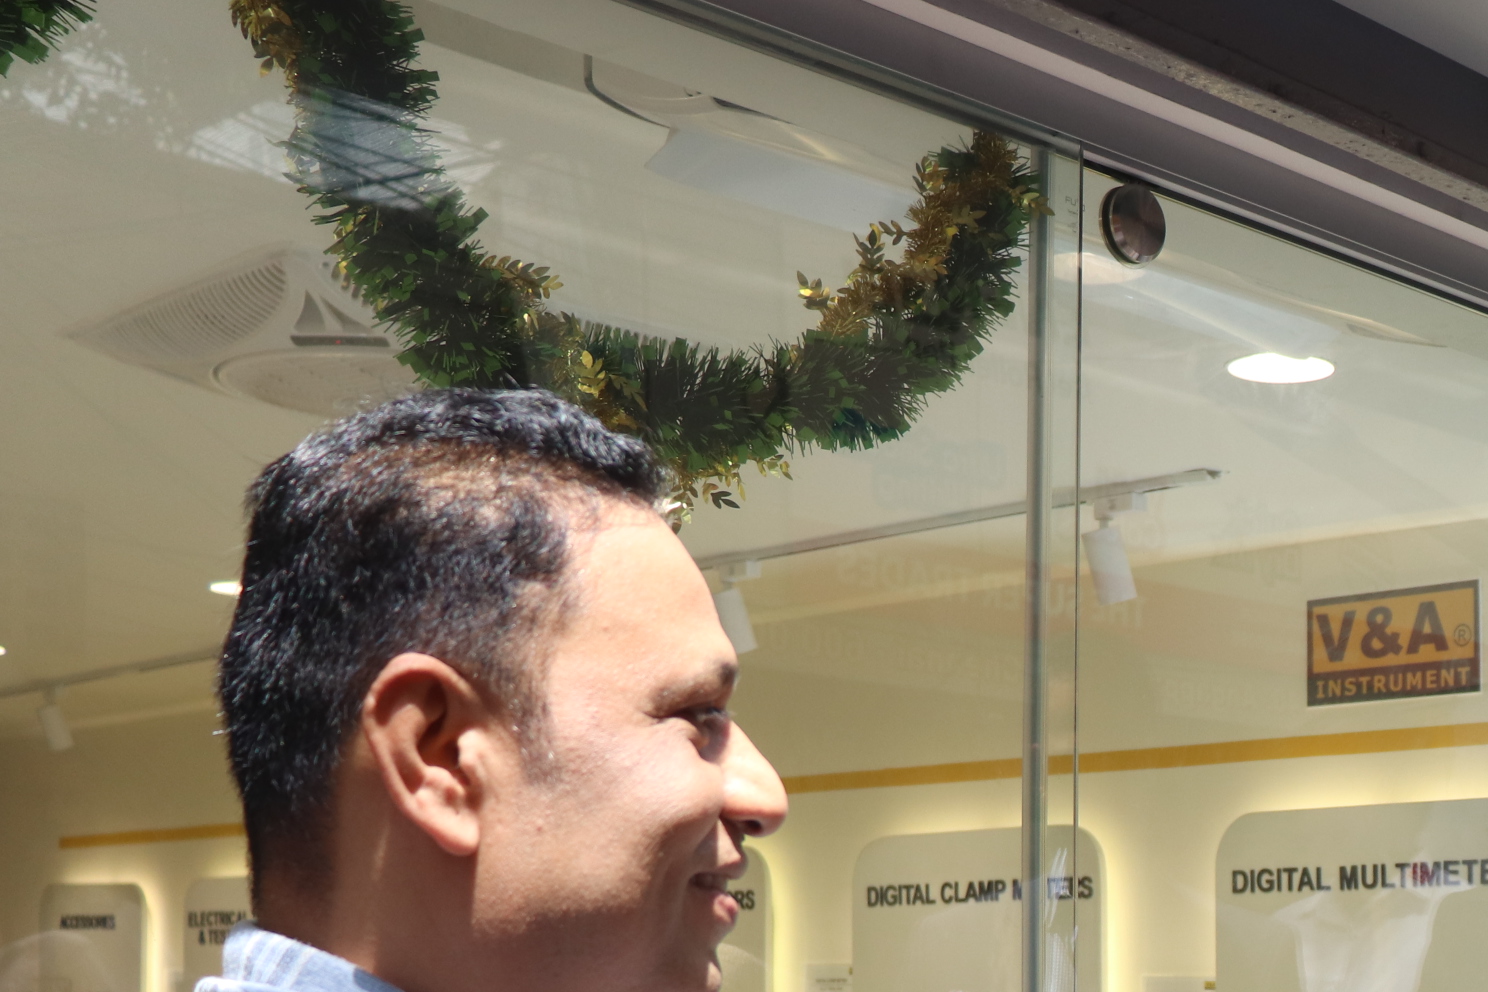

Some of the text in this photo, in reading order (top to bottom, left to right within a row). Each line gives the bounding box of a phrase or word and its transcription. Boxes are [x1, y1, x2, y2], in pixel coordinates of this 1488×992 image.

[1316, 601, 1449, 662] V&A
[1315, 666, 1472, 698] INSTRUMENT
[867, 883, 936, 908] DIGITAL
[940, 879, 1006, 904] CLAMP
[1231, 866, 1331, 893] DIGITAL
